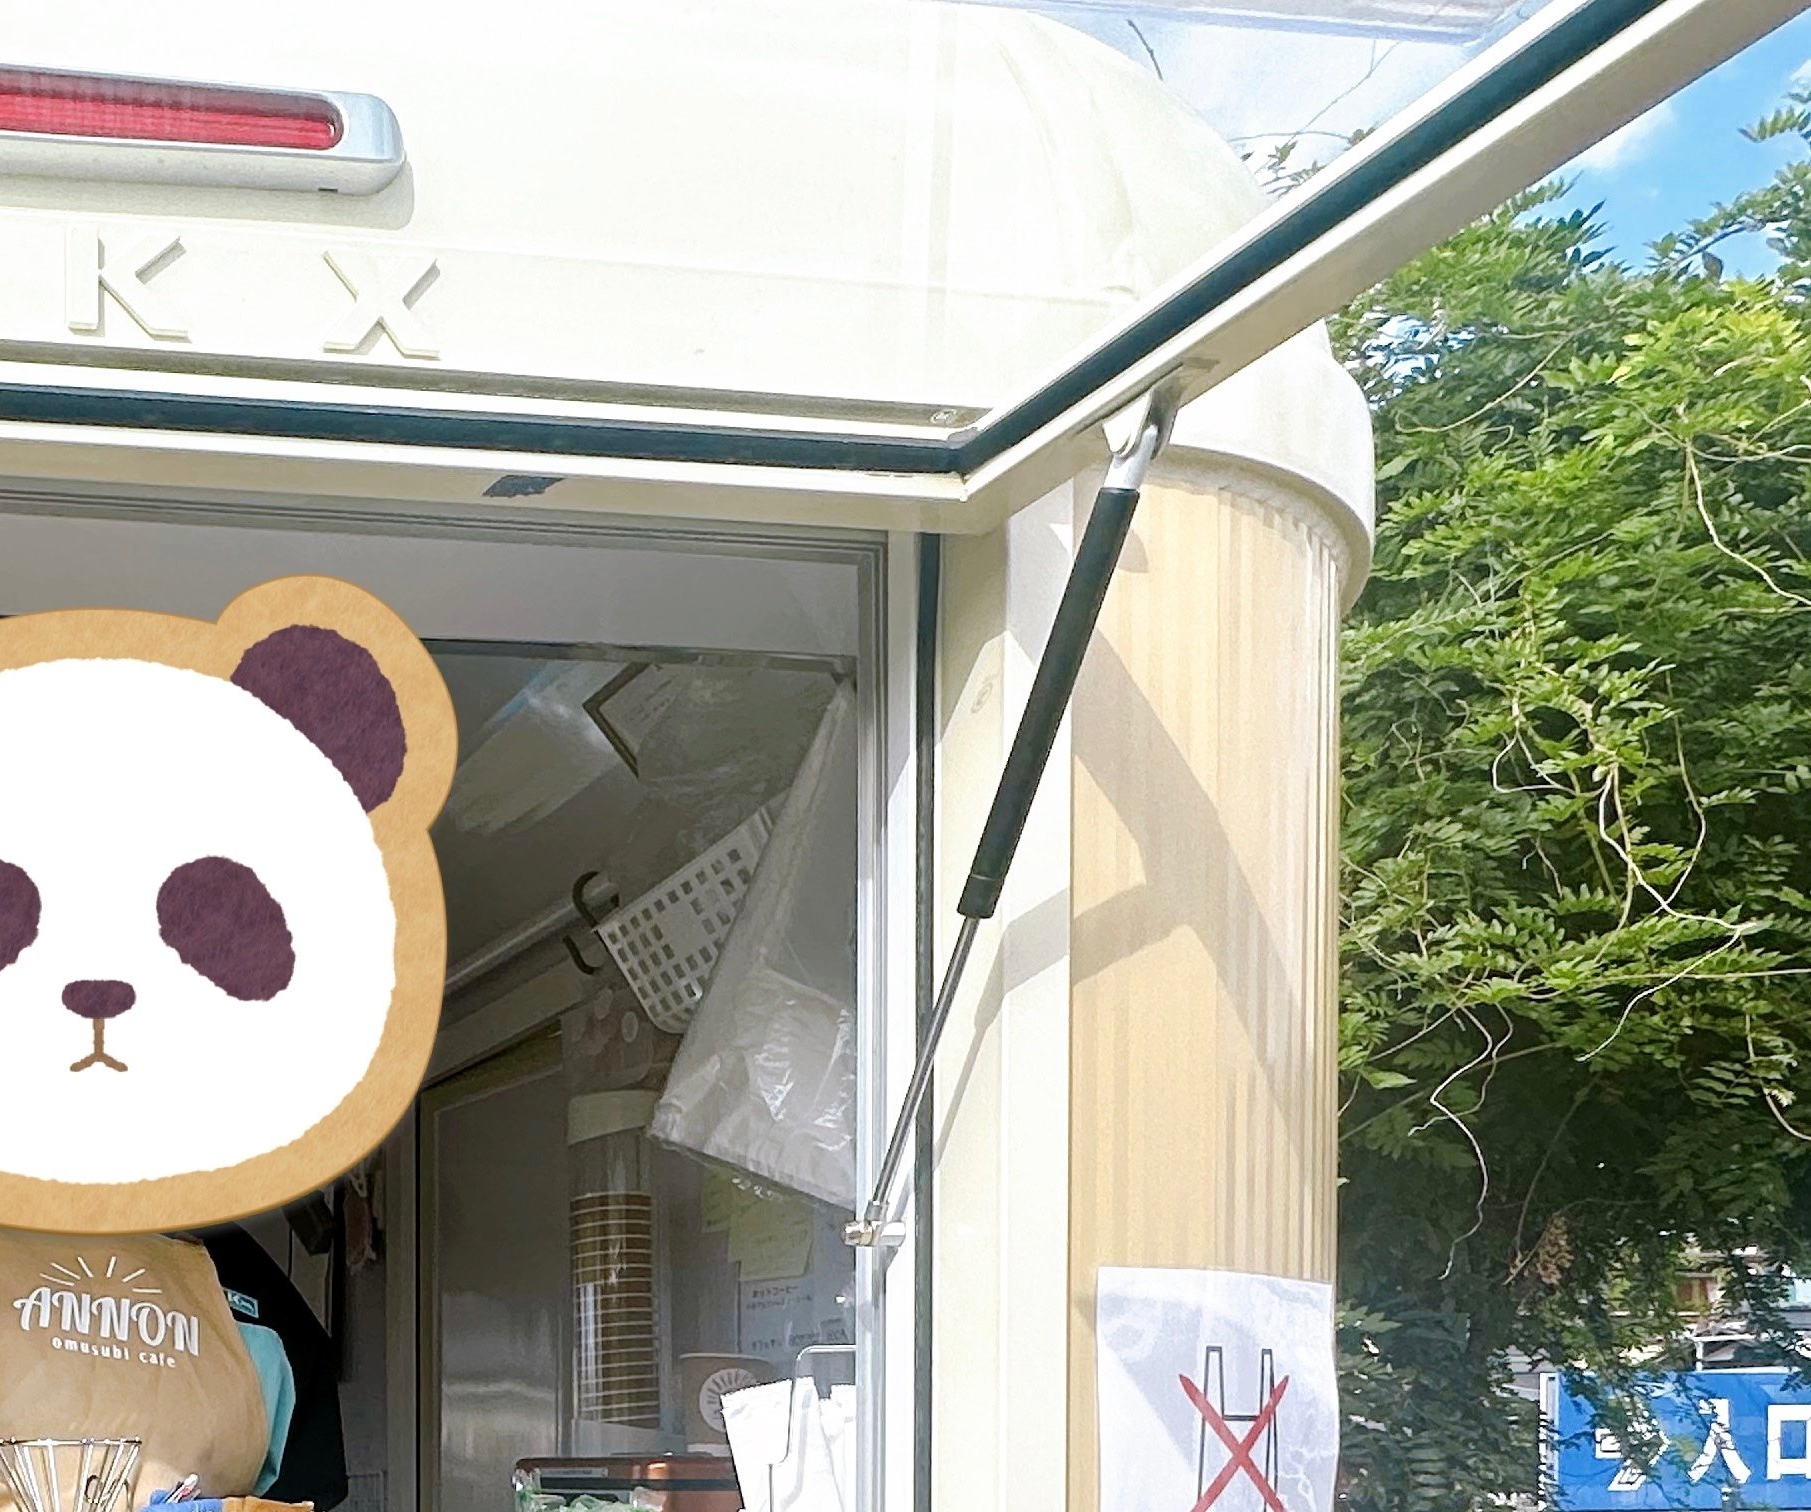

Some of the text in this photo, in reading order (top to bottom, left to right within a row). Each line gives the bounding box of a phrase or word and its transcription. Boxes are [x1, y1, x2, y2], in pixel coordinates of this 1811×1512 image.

[13, 1286, 200, 1357] ANNON
[51, 1336, 177, 1369] omusubi cafe
